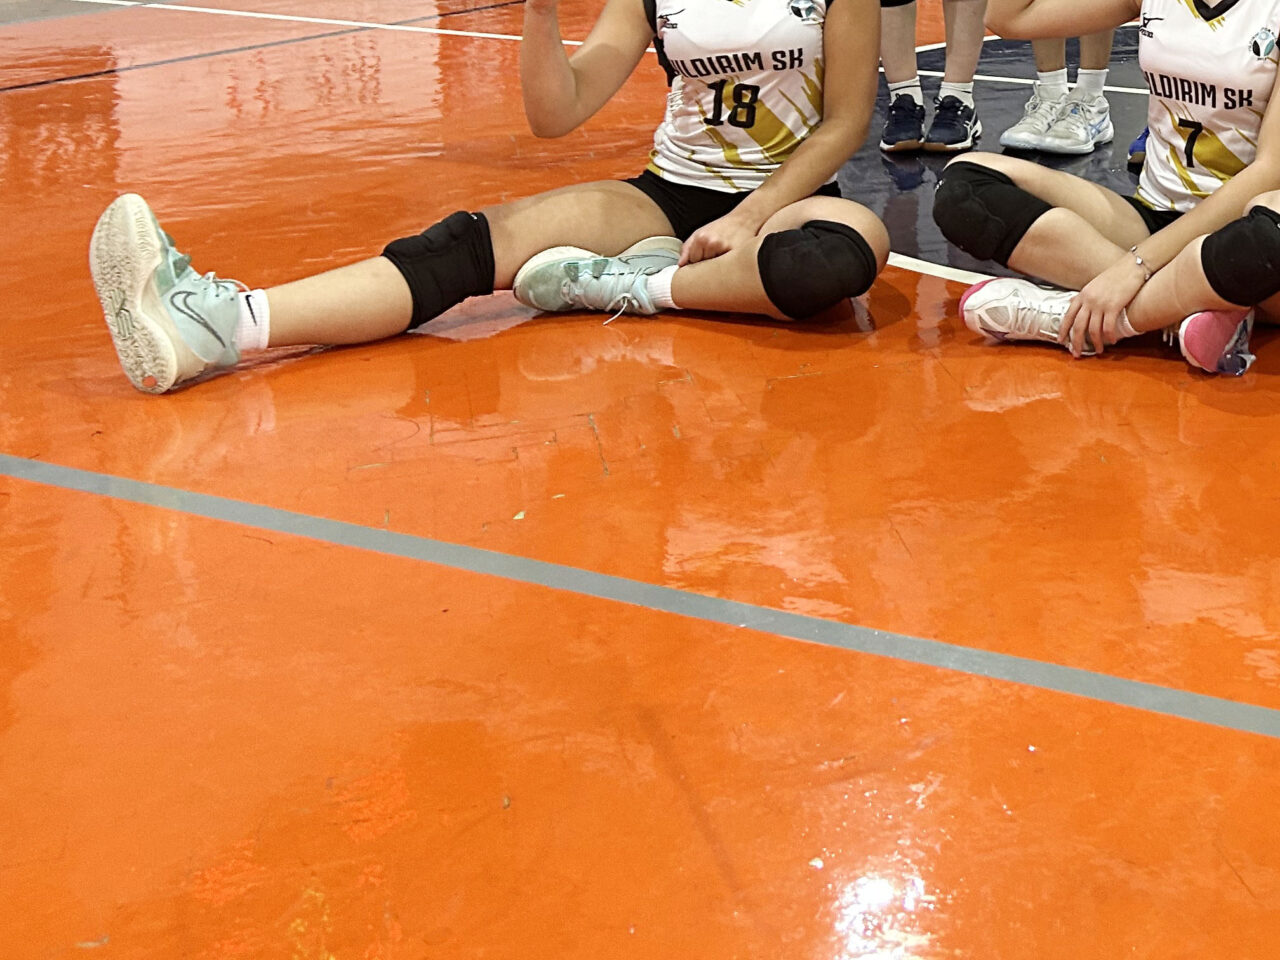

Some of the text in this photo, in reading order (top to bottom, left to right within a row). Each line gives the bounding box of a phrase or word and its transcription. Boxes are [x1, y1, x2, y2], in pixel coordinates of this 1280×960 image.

[771, 48, 803, 71] SK
[703, 79, 760, 128] 18
[1223, 87, 1253, 110] SK
[1178, 117, 1204, 169] 7
